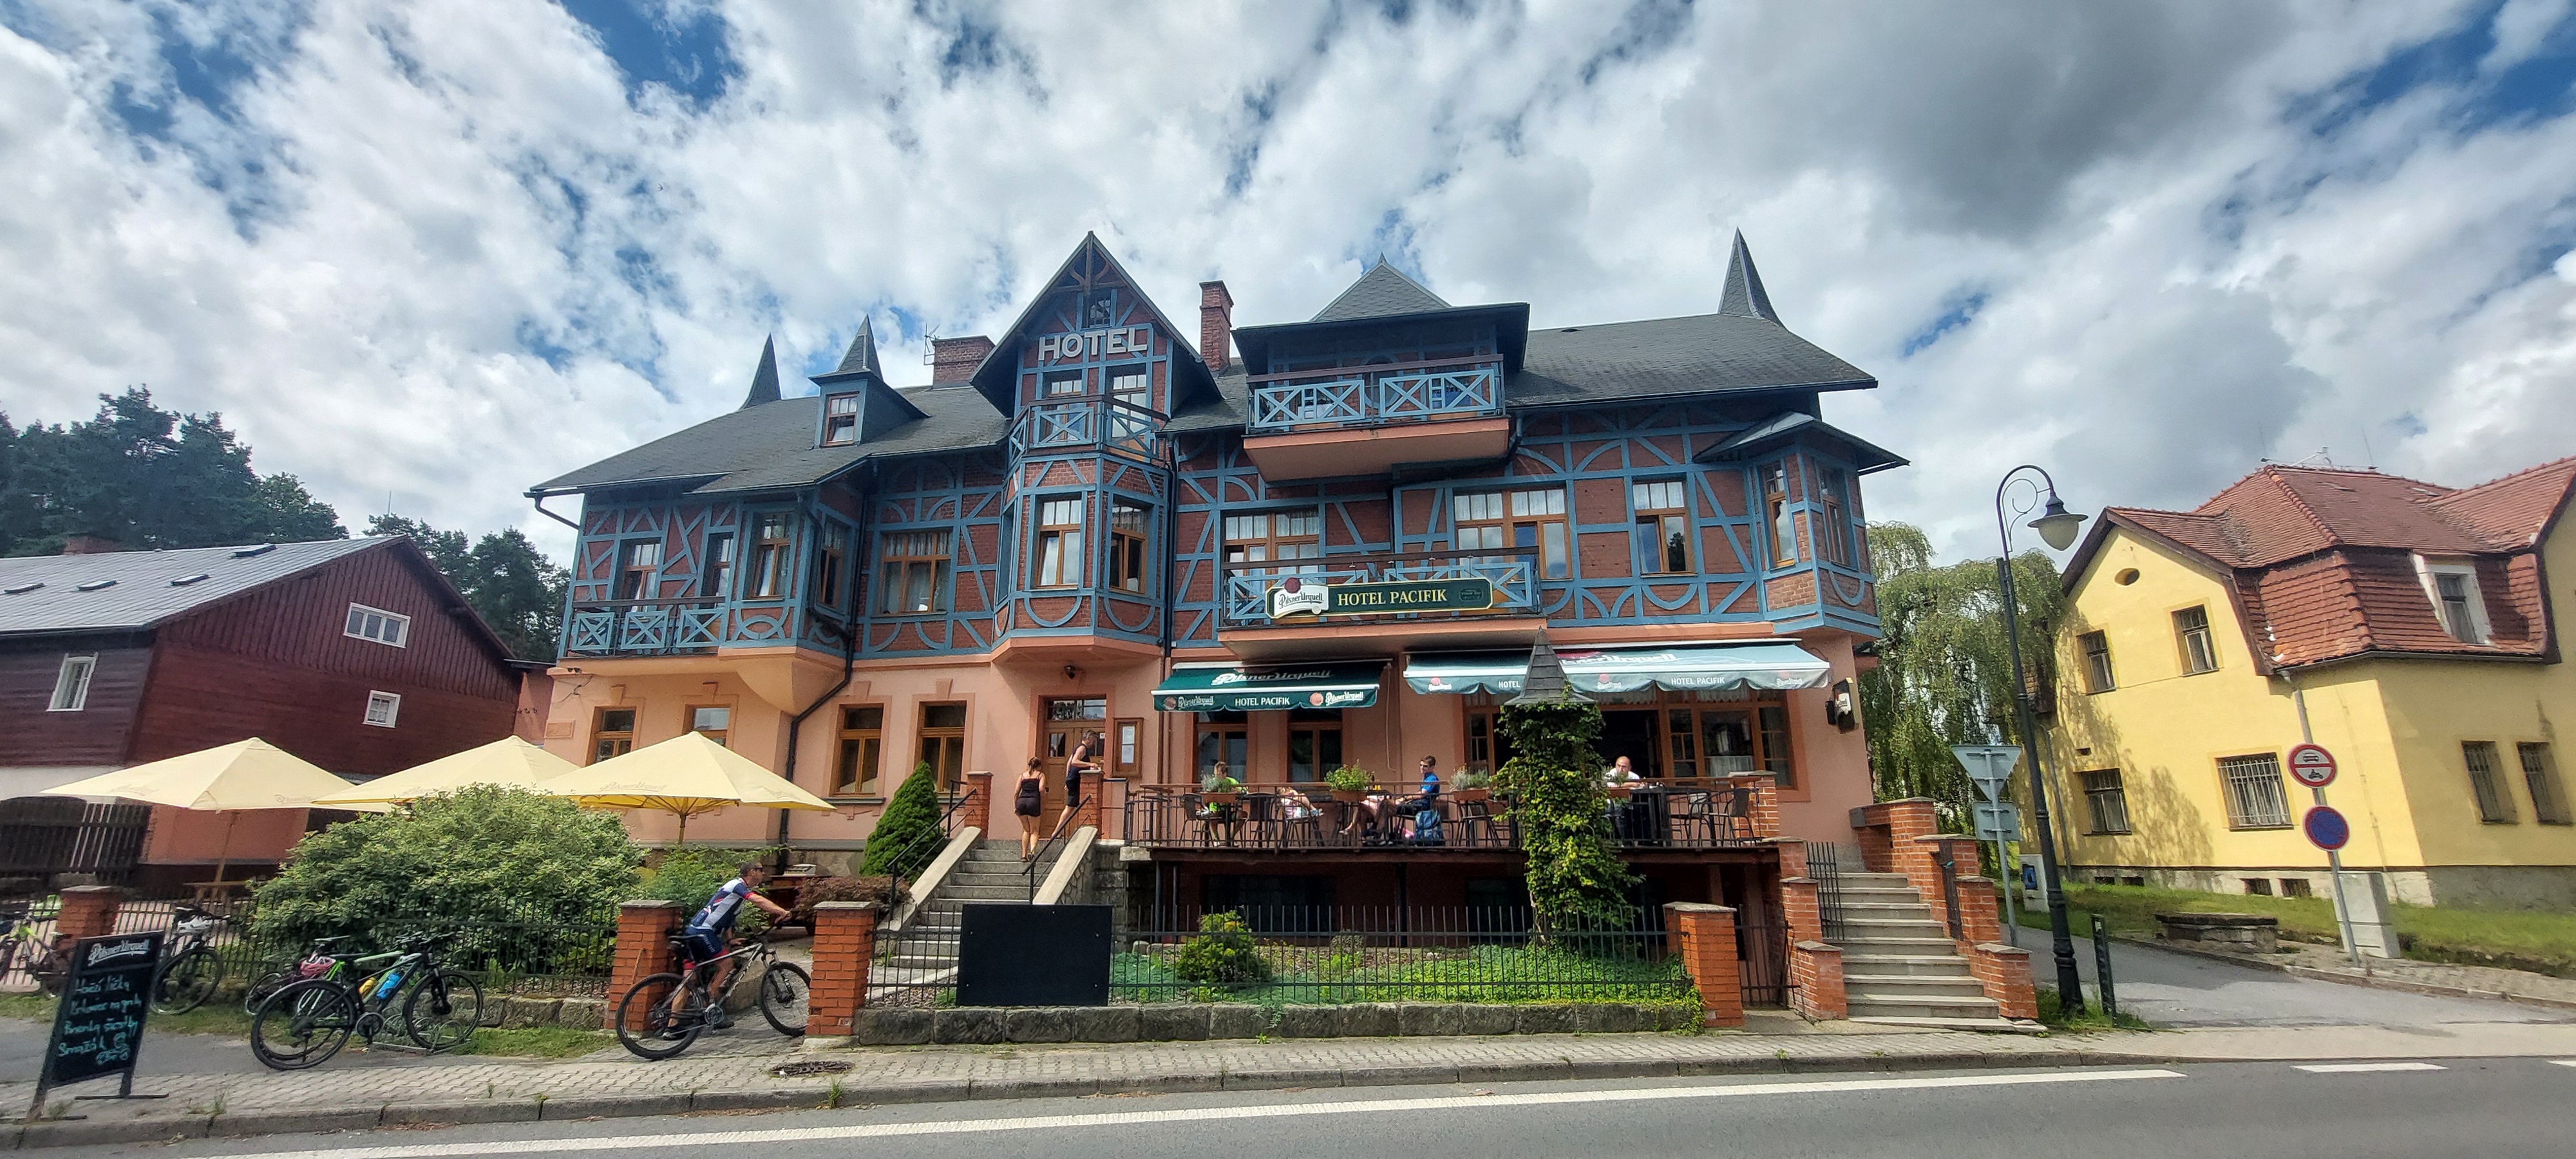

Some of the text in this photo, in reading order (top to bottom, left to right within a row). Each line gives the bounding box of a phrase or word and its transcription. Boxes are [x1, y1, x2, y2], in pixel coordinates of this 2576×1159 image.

[1038, 328, 1148, 361] HOTEL
[1278, 592, 1324, 609] Pilsner Urquell
[1338, 592, 1385, 607] HOTEL
[1389, 589, 1448, 605] PACIFIK
[1211, 672, 1274, 686] Pilsner
[1696, 676, 1725, 684] PACIFIK
[1235, 696, 1291, 706] HOTEL PACIFIK
[1325, 691, 1365, 706] Pilsner Urquell
